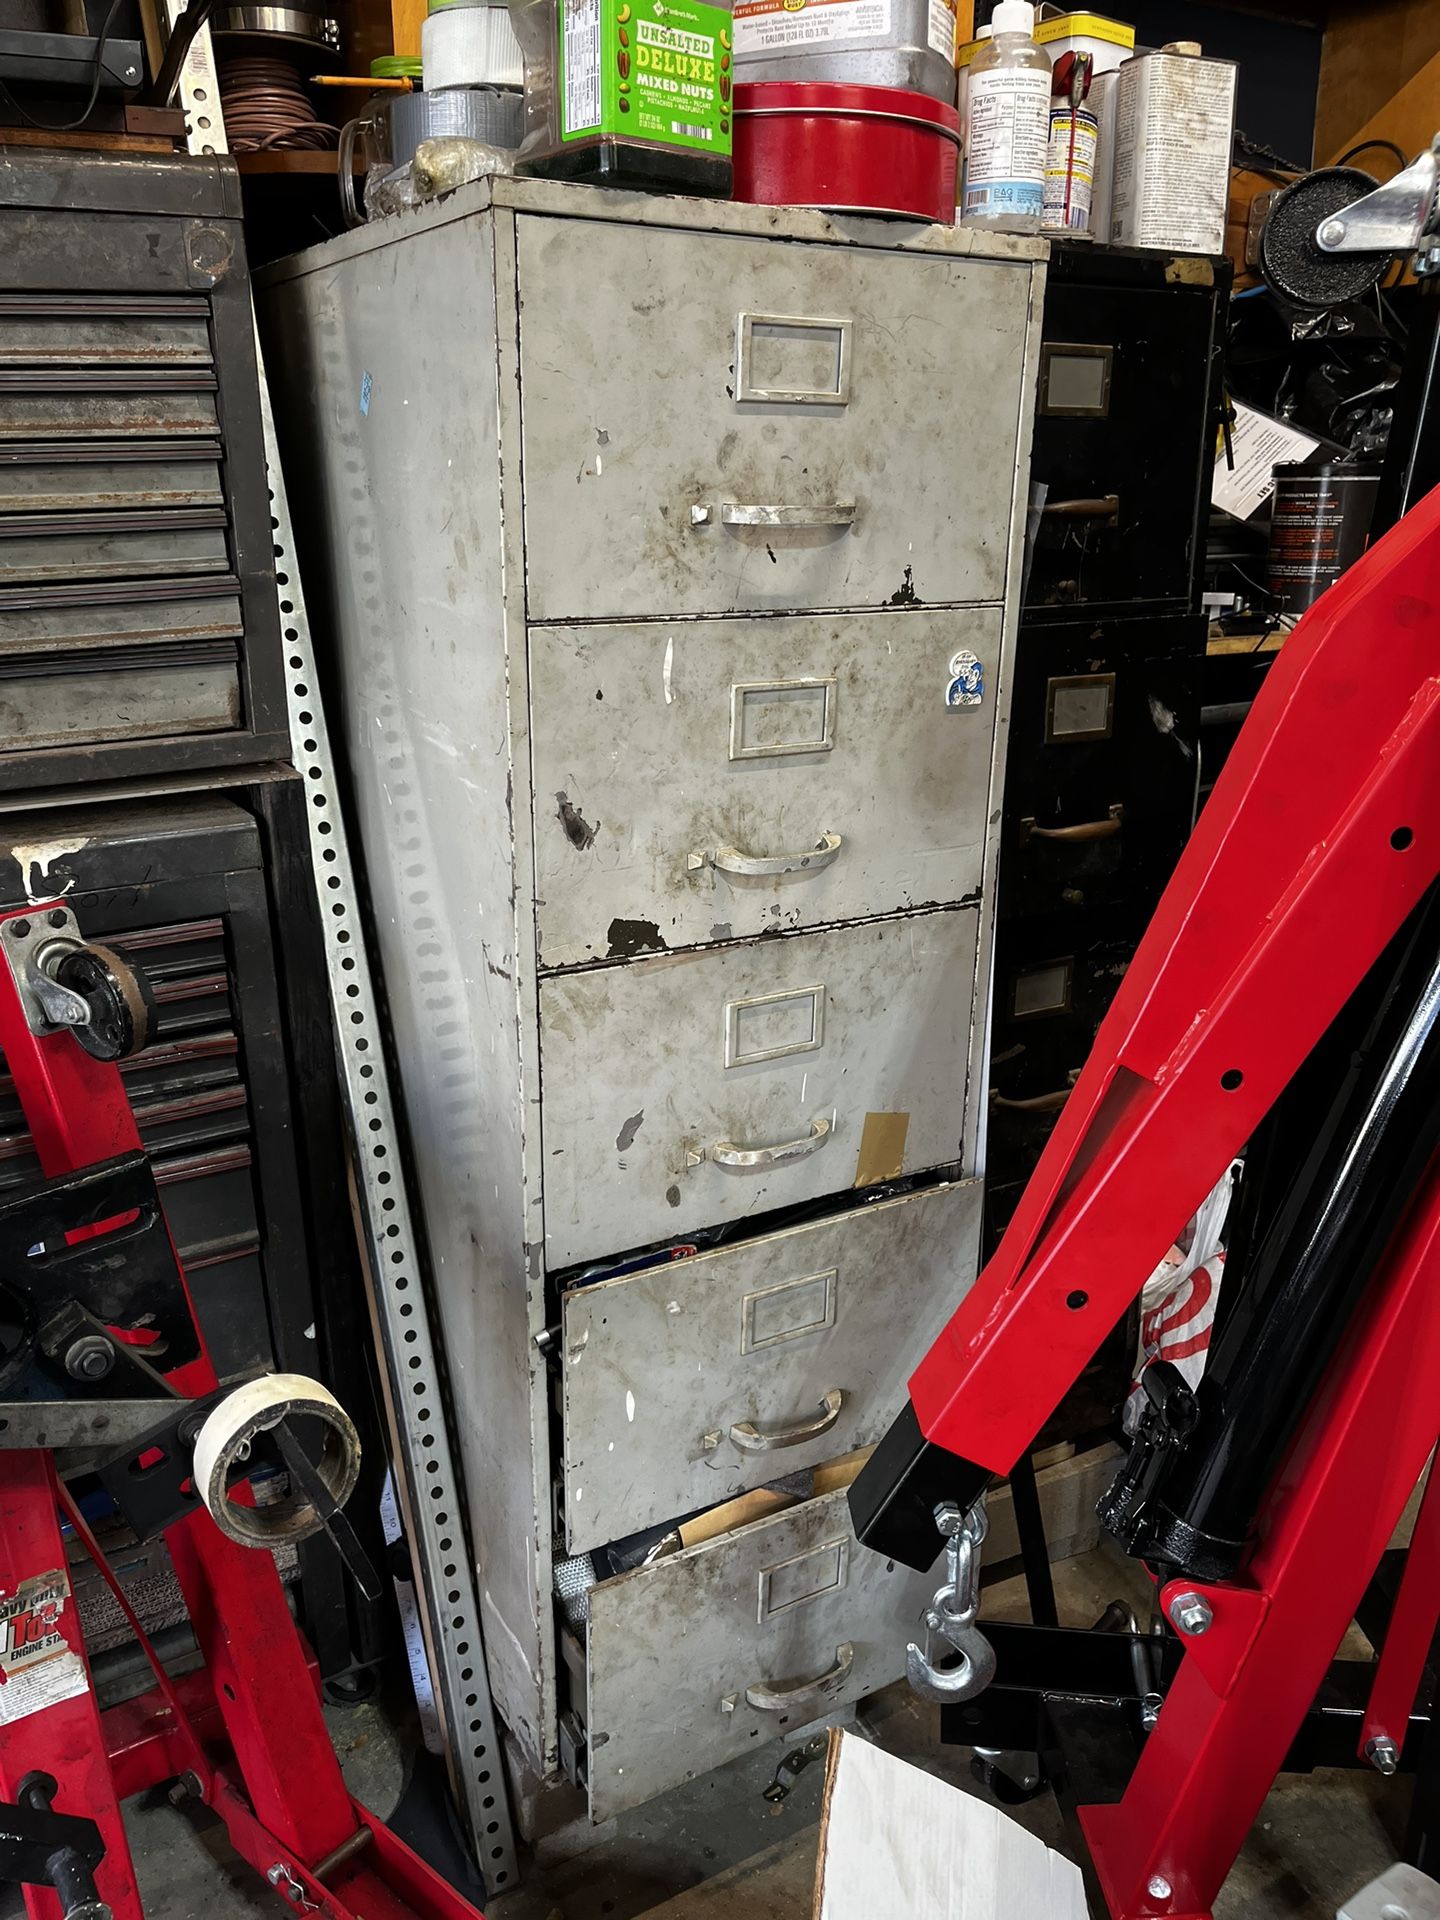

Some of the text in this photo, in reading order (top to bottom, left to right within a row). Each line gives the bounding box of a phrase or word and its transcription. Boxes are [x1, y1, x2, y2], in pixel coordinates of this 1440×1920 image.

[753, 2, 780, 12] FORMULA
[640, 25, 710, 54] UNSALTED
[761, 36, 764, 44] 1
[766, 33, 785, 44] GALLON
[786, 30, 798, 43] (128
[798, 29, 804, 39] FL
[806, 28, 814, 39] OZ)
[636, 44, 714, 82] DELUXE
[636, 72, 714, 101] MIXED NUTS
[11, 1640, 44, 1662] ENGINE
